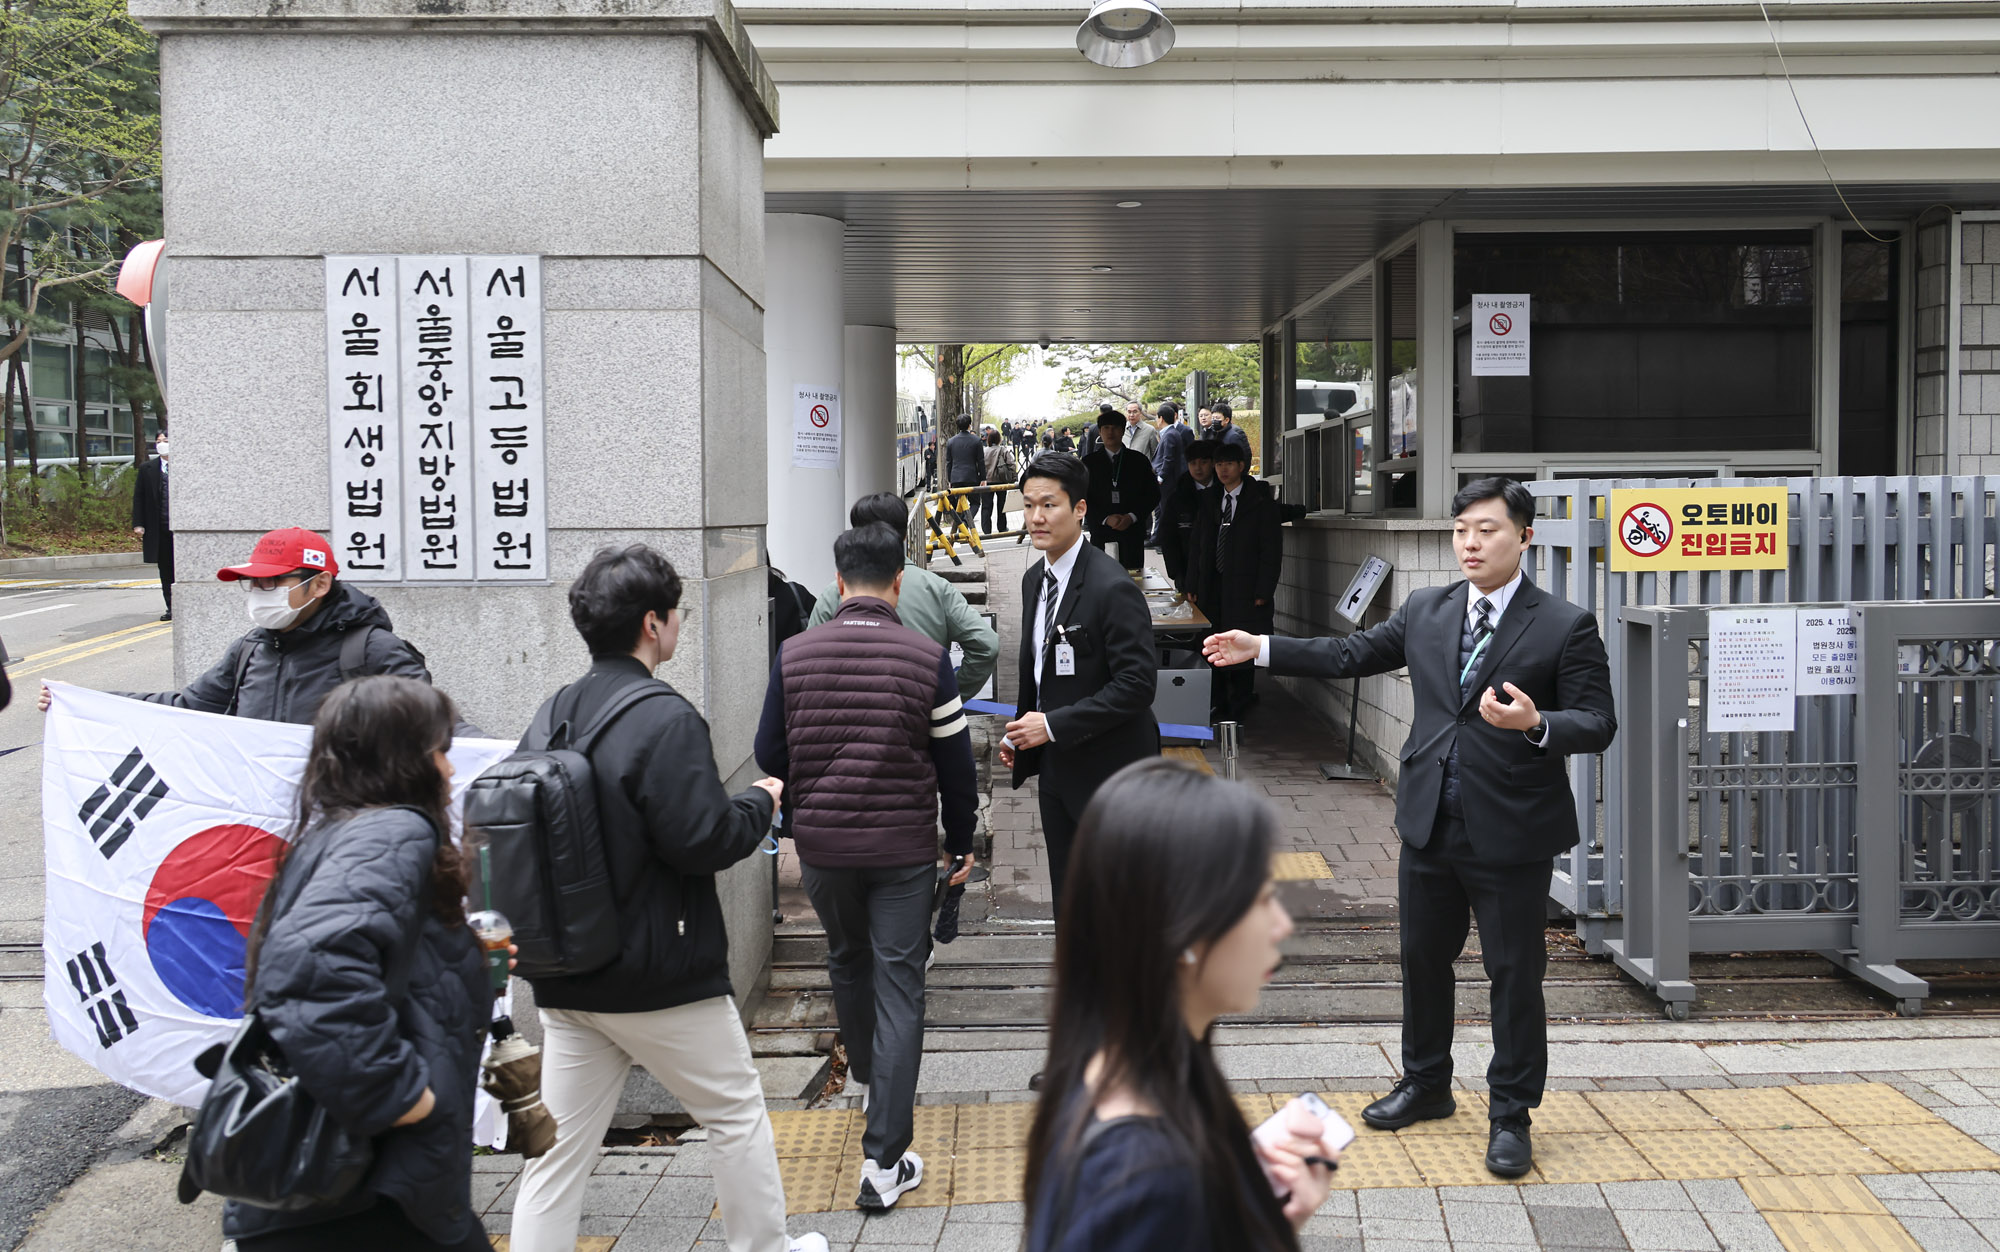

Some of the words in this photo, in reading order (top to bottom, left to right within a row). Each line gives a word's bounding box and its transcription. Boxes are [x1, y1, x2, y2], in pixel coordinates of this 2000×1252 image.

[1500, 301, 1525, 309] 촬영금지
[341, 267, 385, 570] 서울회생법원
[414, 267, 458, 569] 서울중앙지방법원
[486, 266, 532, 569] 서울고등법원
[1681, 503, 1778, 526] 오토바이
[1681, 532, 1776, 557] 진입금지
[1812, 653, 1827, 662] 모든
[1831, 652, 1857, 661] 출입문
[1807, 665, 1822, 674] 법원
[1825, 665, 1841, 674] 출입
[1844, 665, 1852, 673] 시
